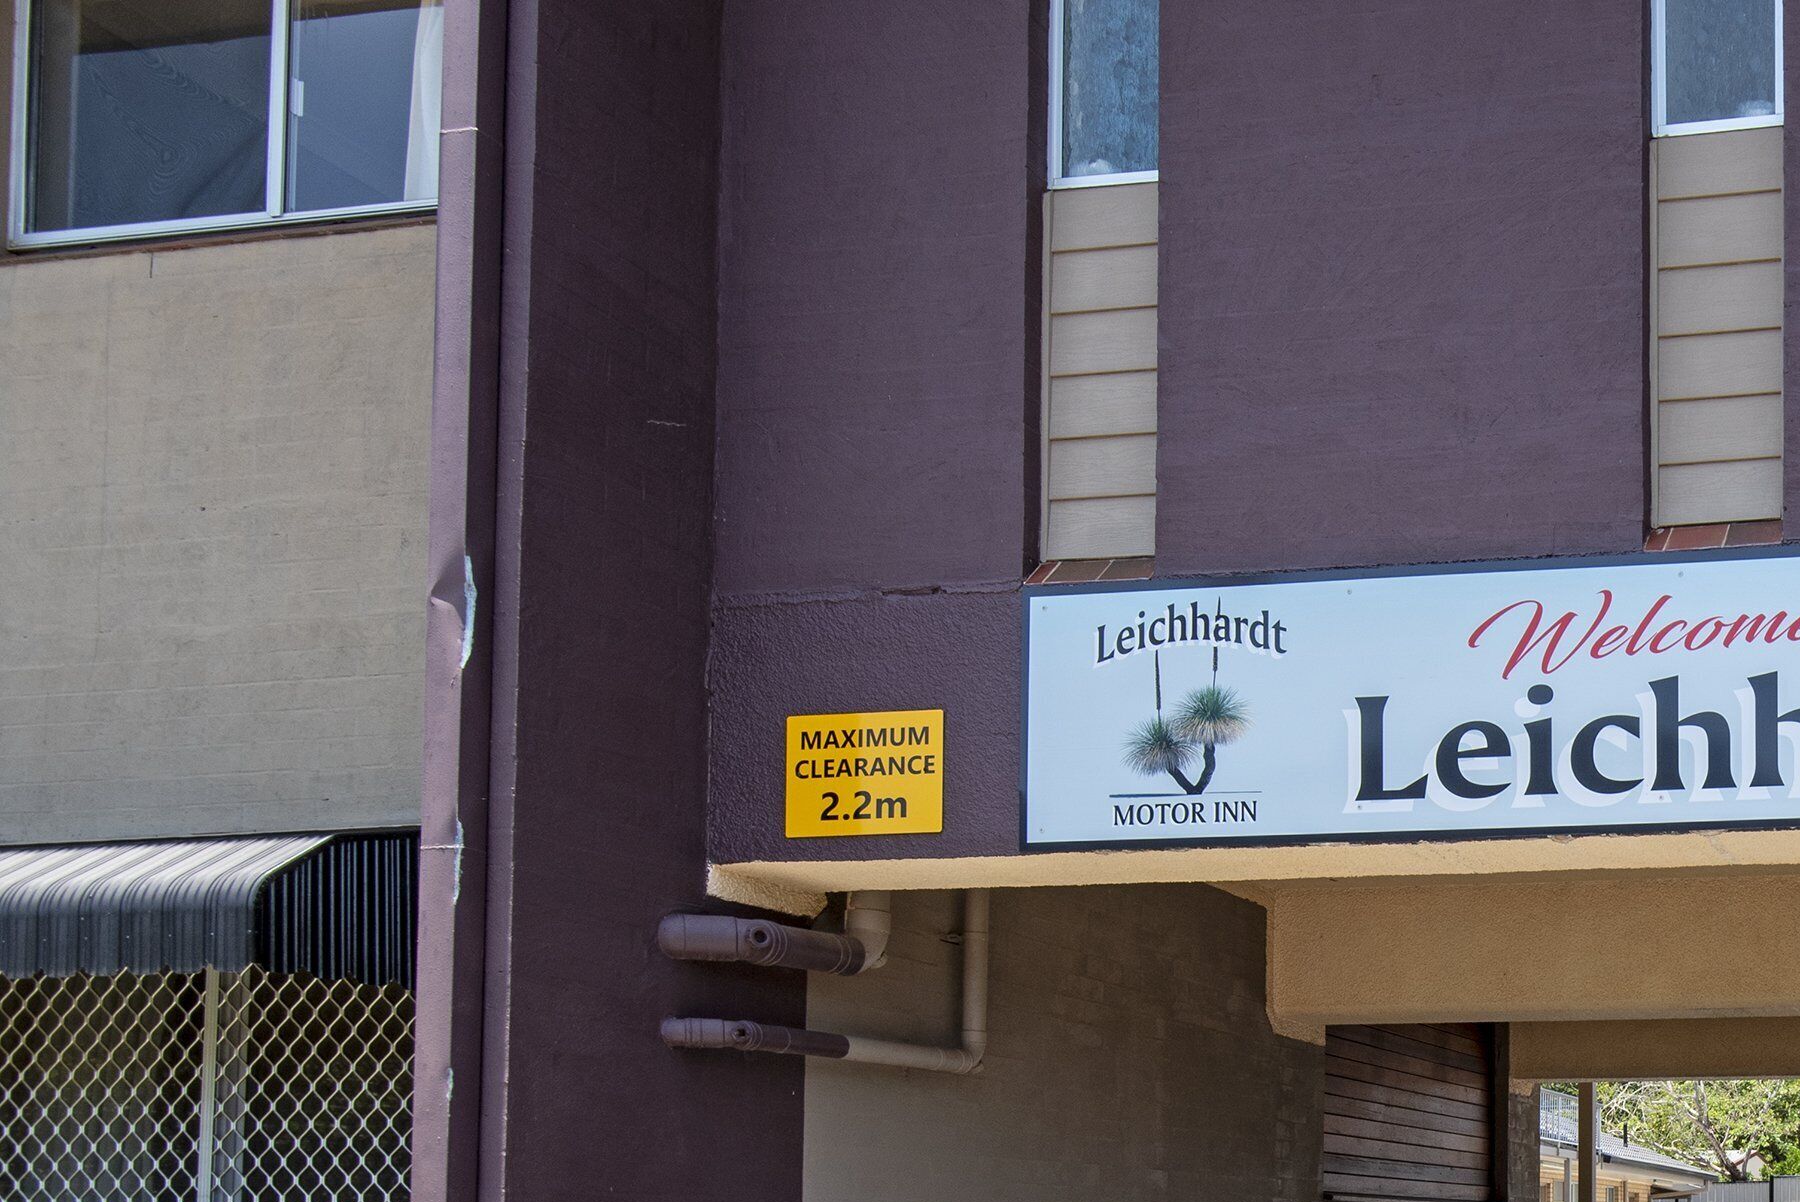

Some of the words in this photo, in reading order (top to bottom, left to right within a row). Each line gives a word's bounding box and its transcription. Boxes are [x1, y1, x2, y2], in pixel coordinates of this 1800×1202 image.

[1096, 601, 1288, 664] Leichhardt
[800, 726, 930, 750] MAXIMUM
[794, 755, 936, 779] CLEARANCE
[820, 791, 907, 821] 2.2m
[1113, 802, 1207, 826] MOTOR
[1214, 800, 1258, 823] INN
